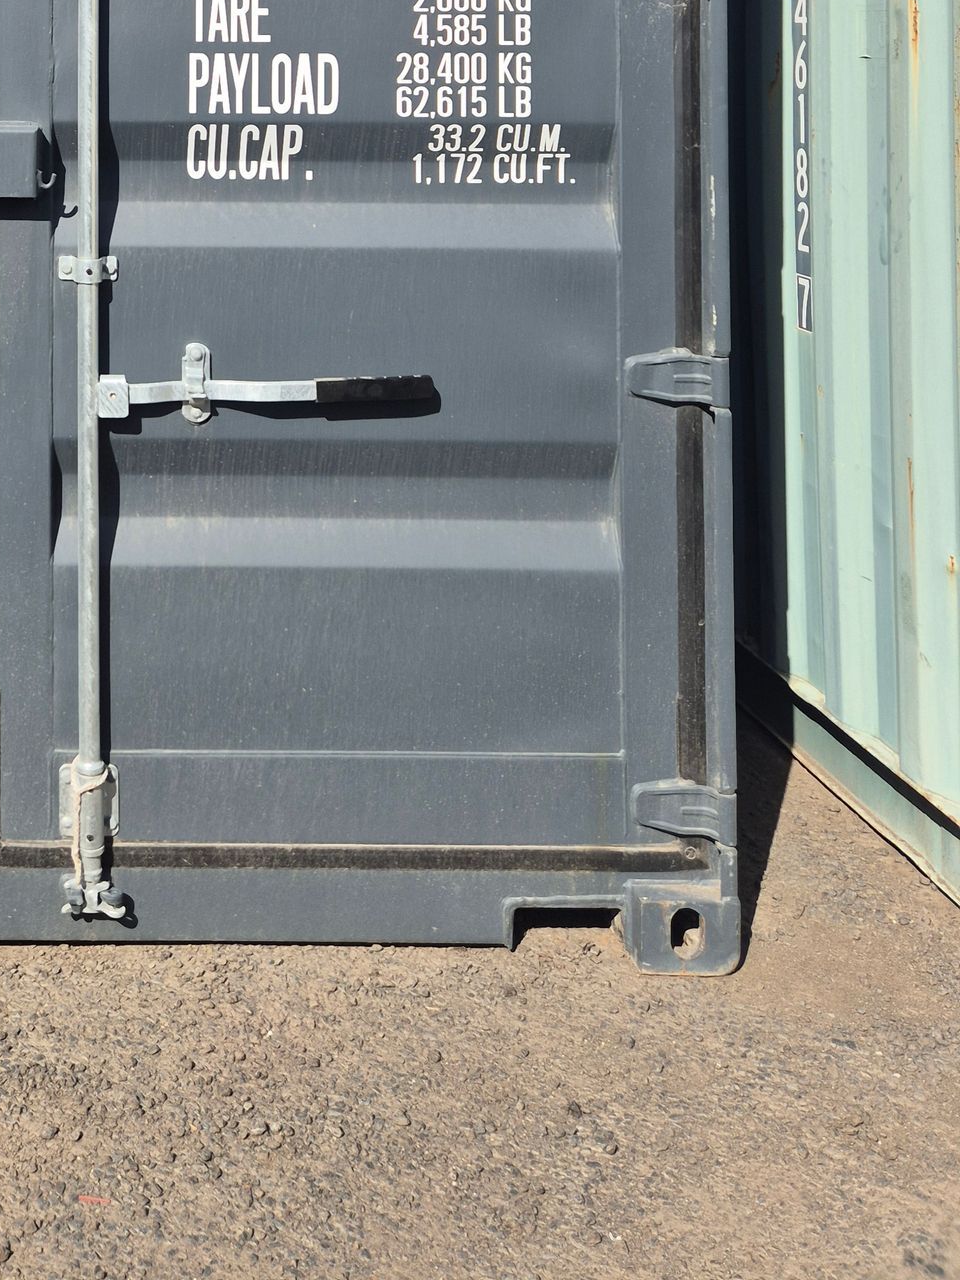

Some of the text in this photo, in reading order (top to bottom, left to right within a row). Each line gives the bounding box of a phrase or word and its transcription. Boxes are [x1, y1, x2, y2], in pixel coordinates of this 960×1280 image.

[412, 14, 532, 47] 4,585 LB
[188, 52, 533, 115] PAYLOAD 28,400 KG
[396, 85, 532, 119] 62,615 LB
[186, 123, 566, 181] CU.CAP. 33.2 CU.M.
[412, 152, 576, 185] 1,172 CU.FT.
[797, 276, 810, 329] 7
